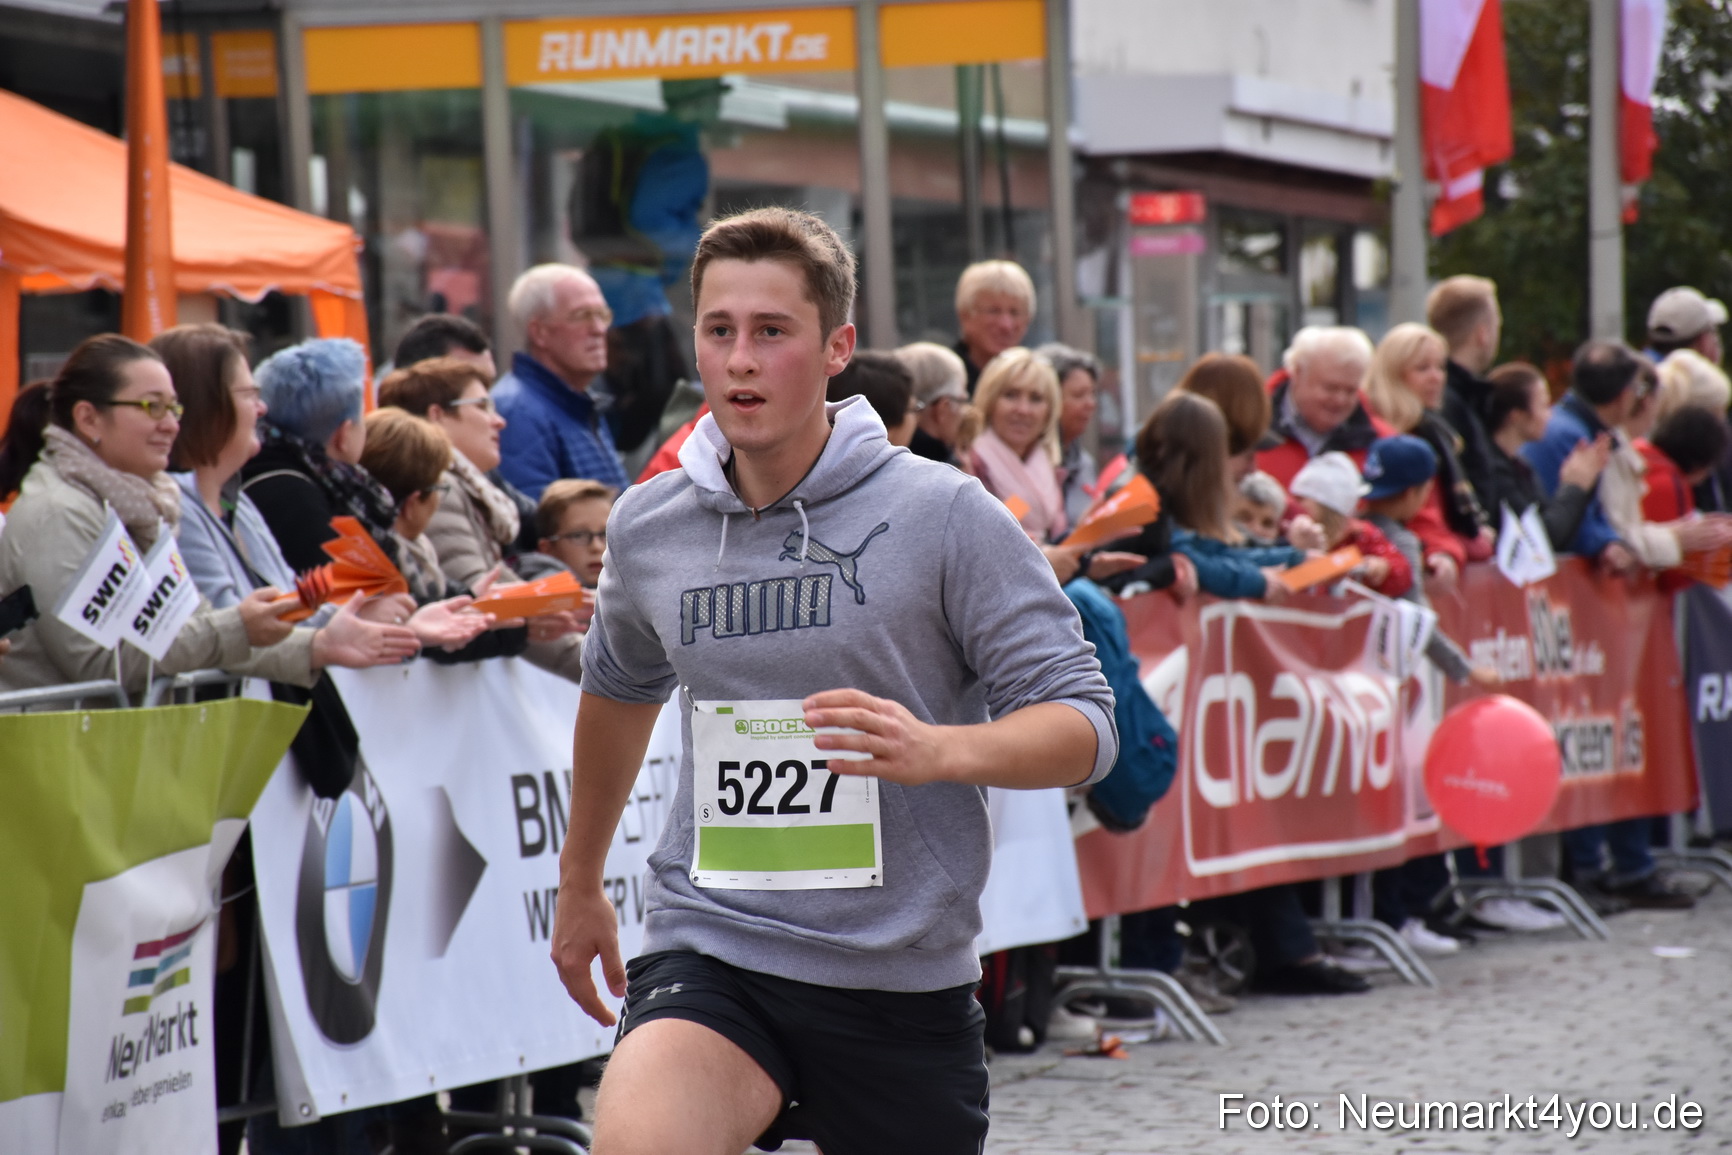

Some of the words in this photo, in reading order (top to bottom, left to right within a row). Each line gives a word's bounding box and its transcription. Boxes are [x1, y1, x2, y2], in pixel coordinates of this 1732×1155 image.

[82, 562, 128, 626] swn
[132, 575, 177, 636] swn
[680, 573, 833, 646] PUMA
[703, 808, 709, 818] S
[717, 759, 842, 816] 5227
